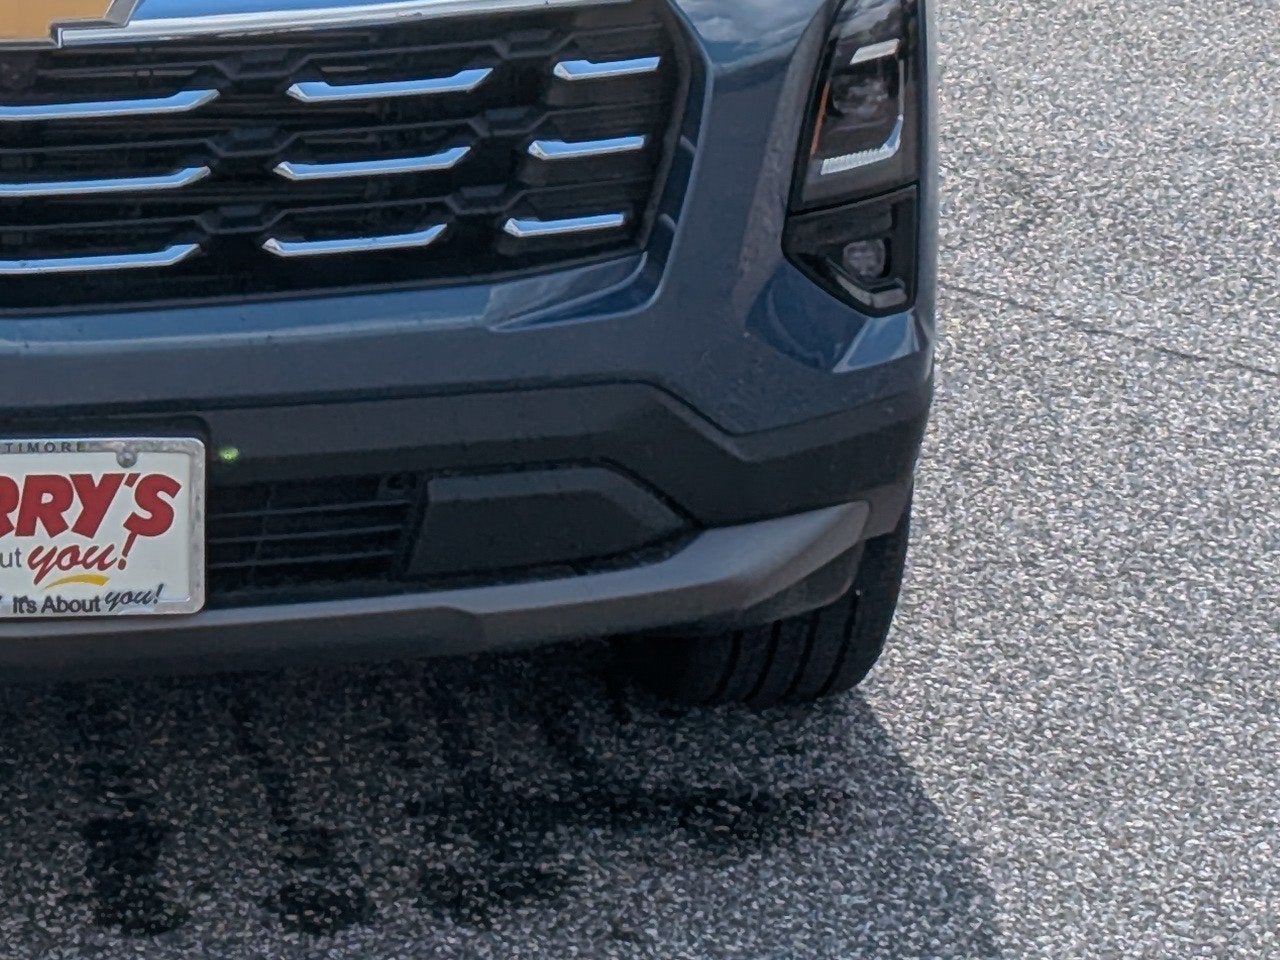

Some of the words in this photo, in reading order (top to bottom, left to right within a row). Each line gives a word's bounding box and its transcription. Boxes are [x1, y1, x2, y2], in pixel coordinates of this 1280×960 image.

[27, 533, 137, 585] you!
[12, 596, 38, 614] It's
[40, 595, 101, 613] About
[105, 583, 165, 611] you!
